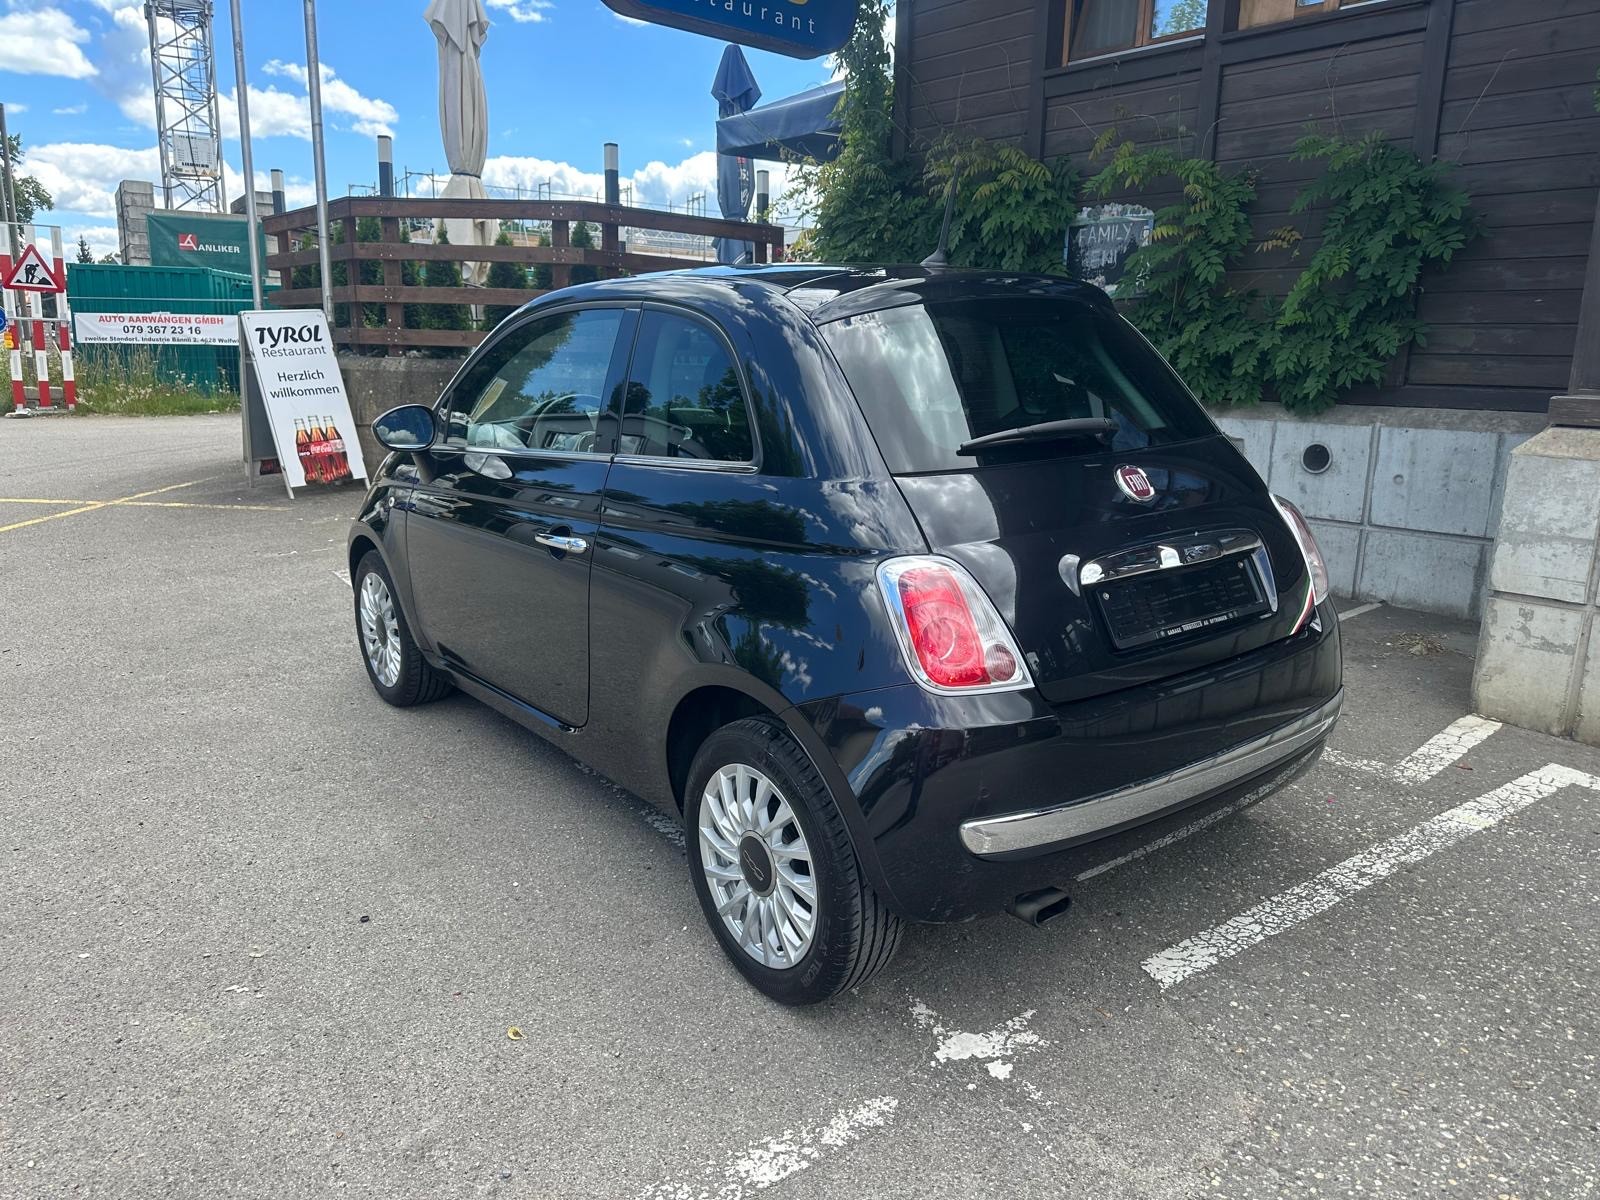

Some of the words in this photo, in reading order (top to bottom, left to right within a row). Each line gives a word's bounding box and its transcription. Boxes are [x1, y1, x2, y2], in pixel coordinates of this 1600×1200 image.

[695, 0, 815, 34] aurant
[1079, 223, 1133, 246] FAMILY
[198, 244, 240, 253] ANLIKER
[98, 315, 125, 323] AUTO
[195, 316, 224, 325] GMBH
[122, 325, 144, 334] 079
[147, 325, 167, 335] 367
[170, 326, 184, 335] 23
[188, 326, 202, 335] 16
[255, 325, 323, 348] TYROL
[261, 346, 327, 358] Restaurant
[277, 369, 325, 382] Herzlich
[270, 385, 340, 399] willkommen
[1125, 474, 1148, 491] FIAT
